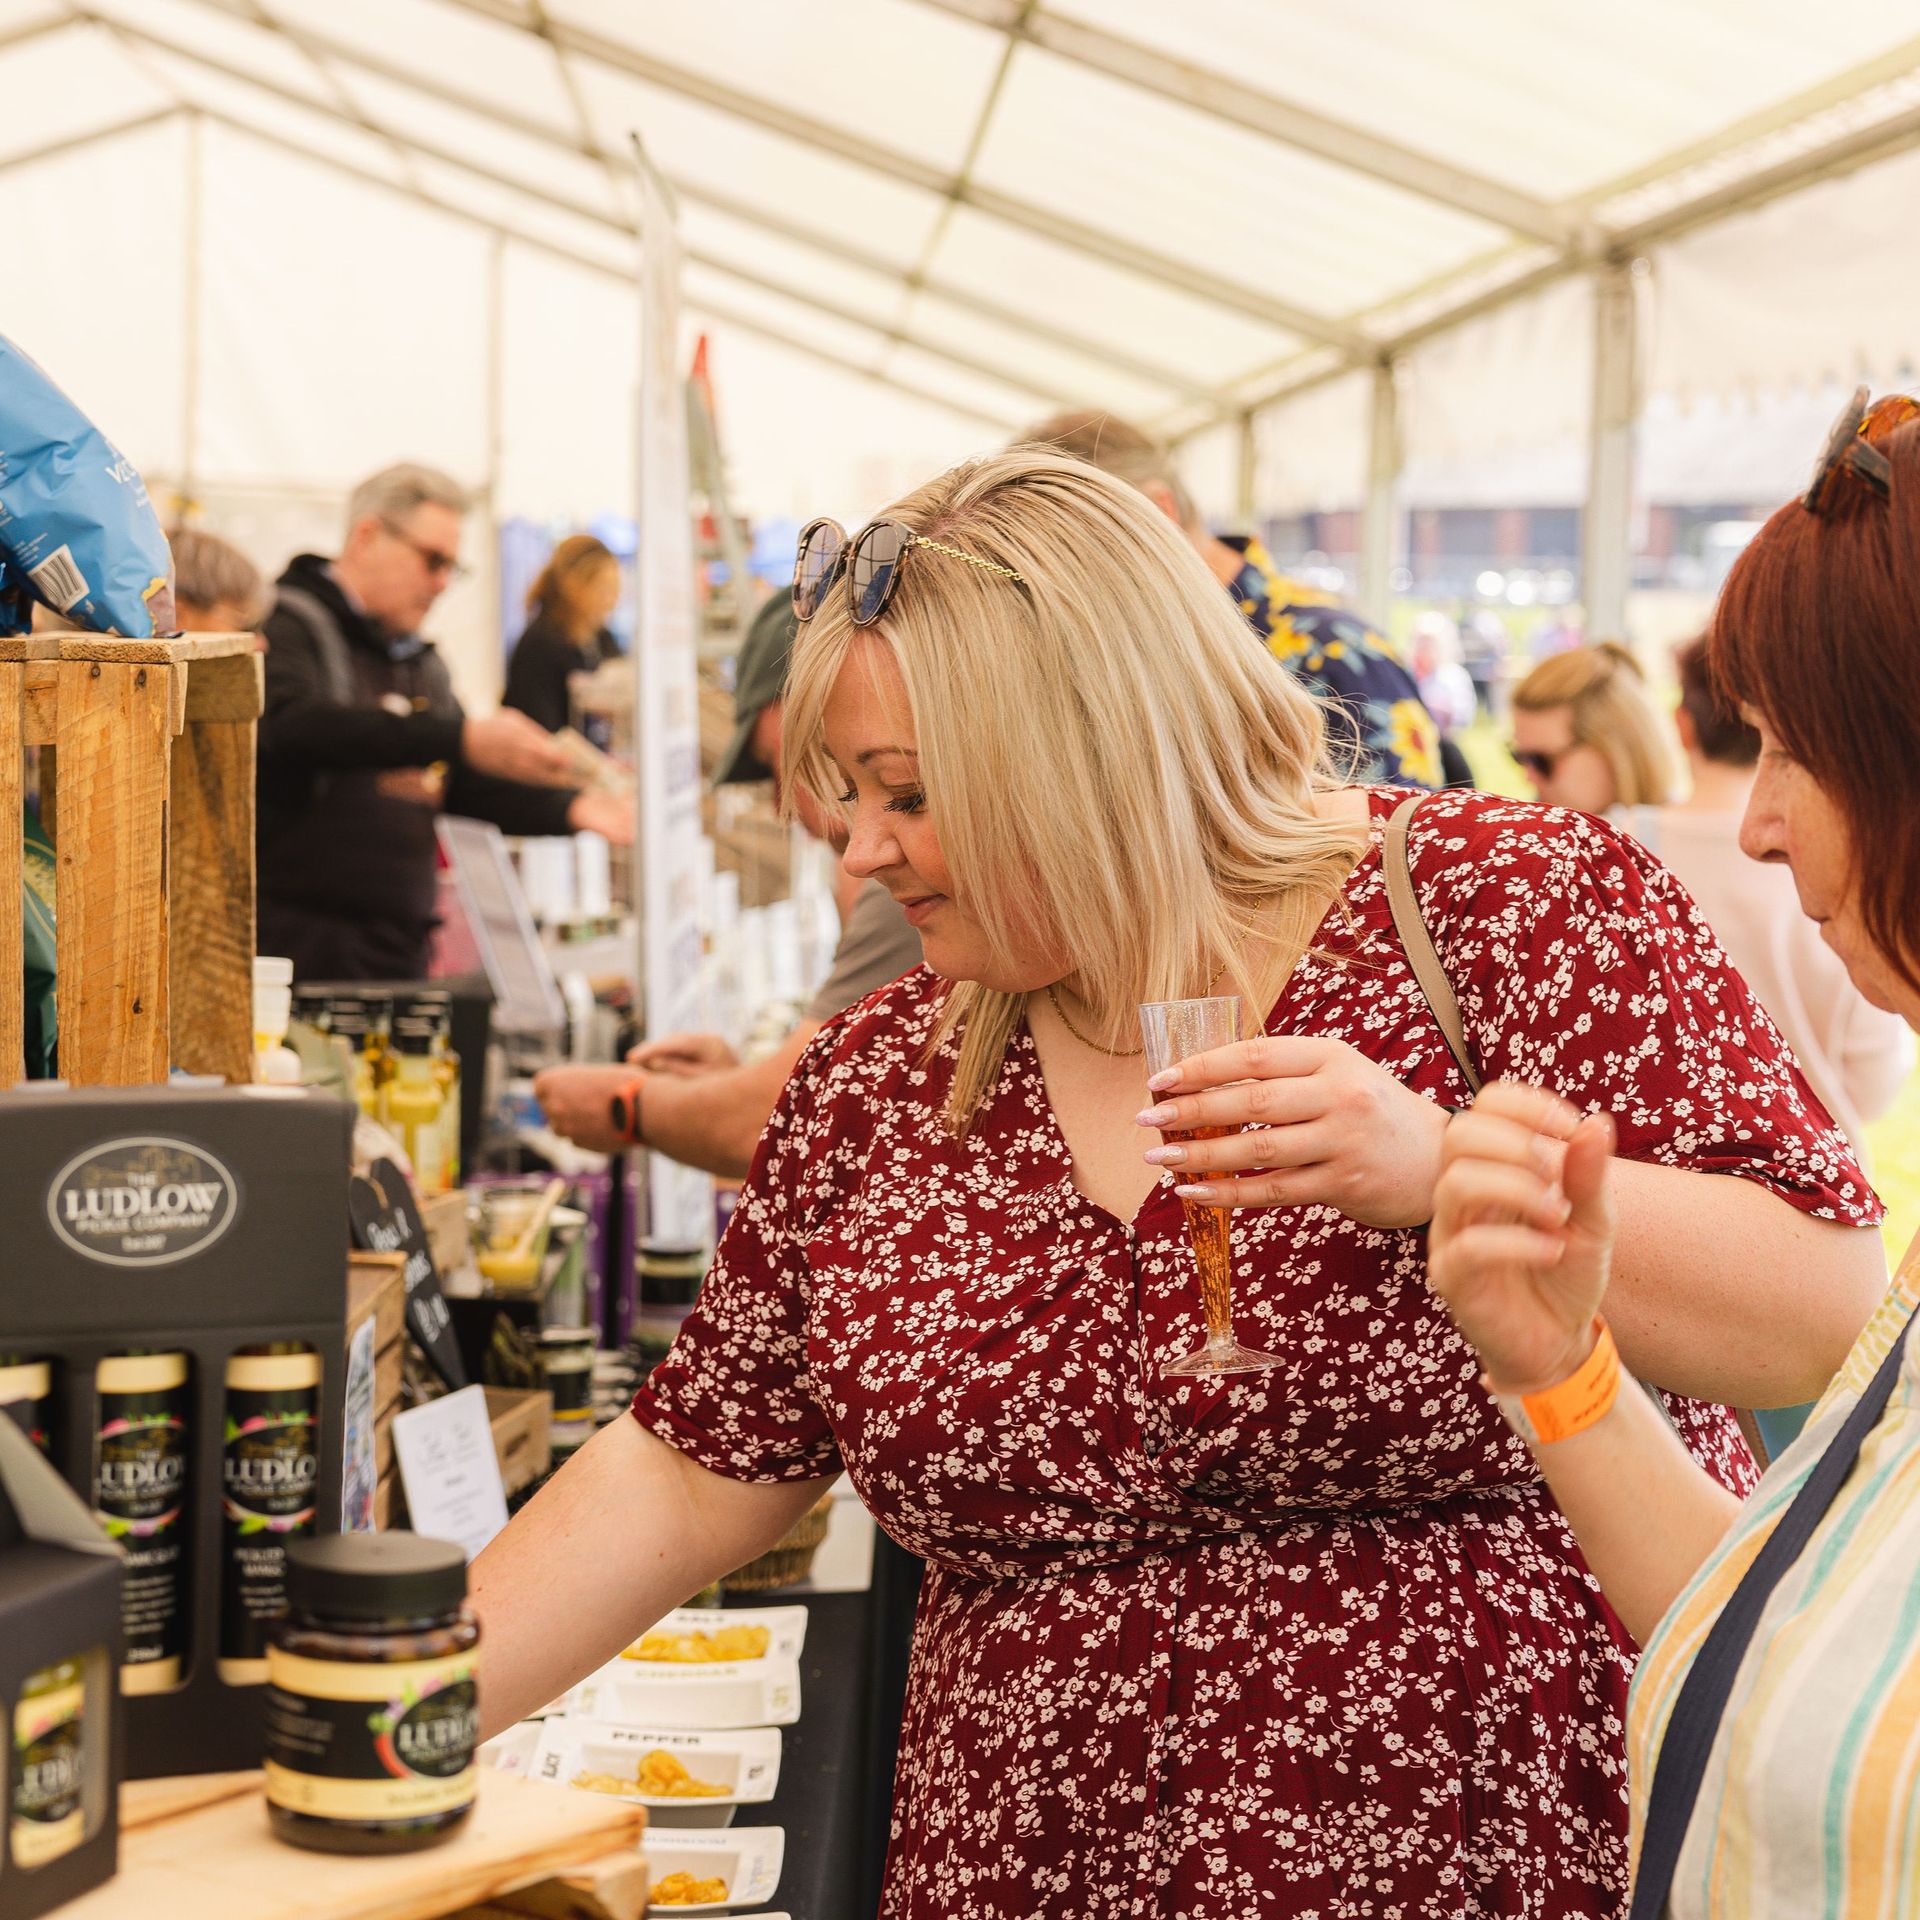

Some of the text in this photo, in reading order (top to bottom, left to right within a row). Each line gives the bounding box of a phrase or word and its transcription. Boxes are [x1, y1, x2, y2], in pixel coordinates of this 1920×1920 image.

[65, 1182, 223, 1221] LUDLOW
[97, 1454, 184, 1489] UDLO
[612, 1730, 701, 1745] PEPPER
